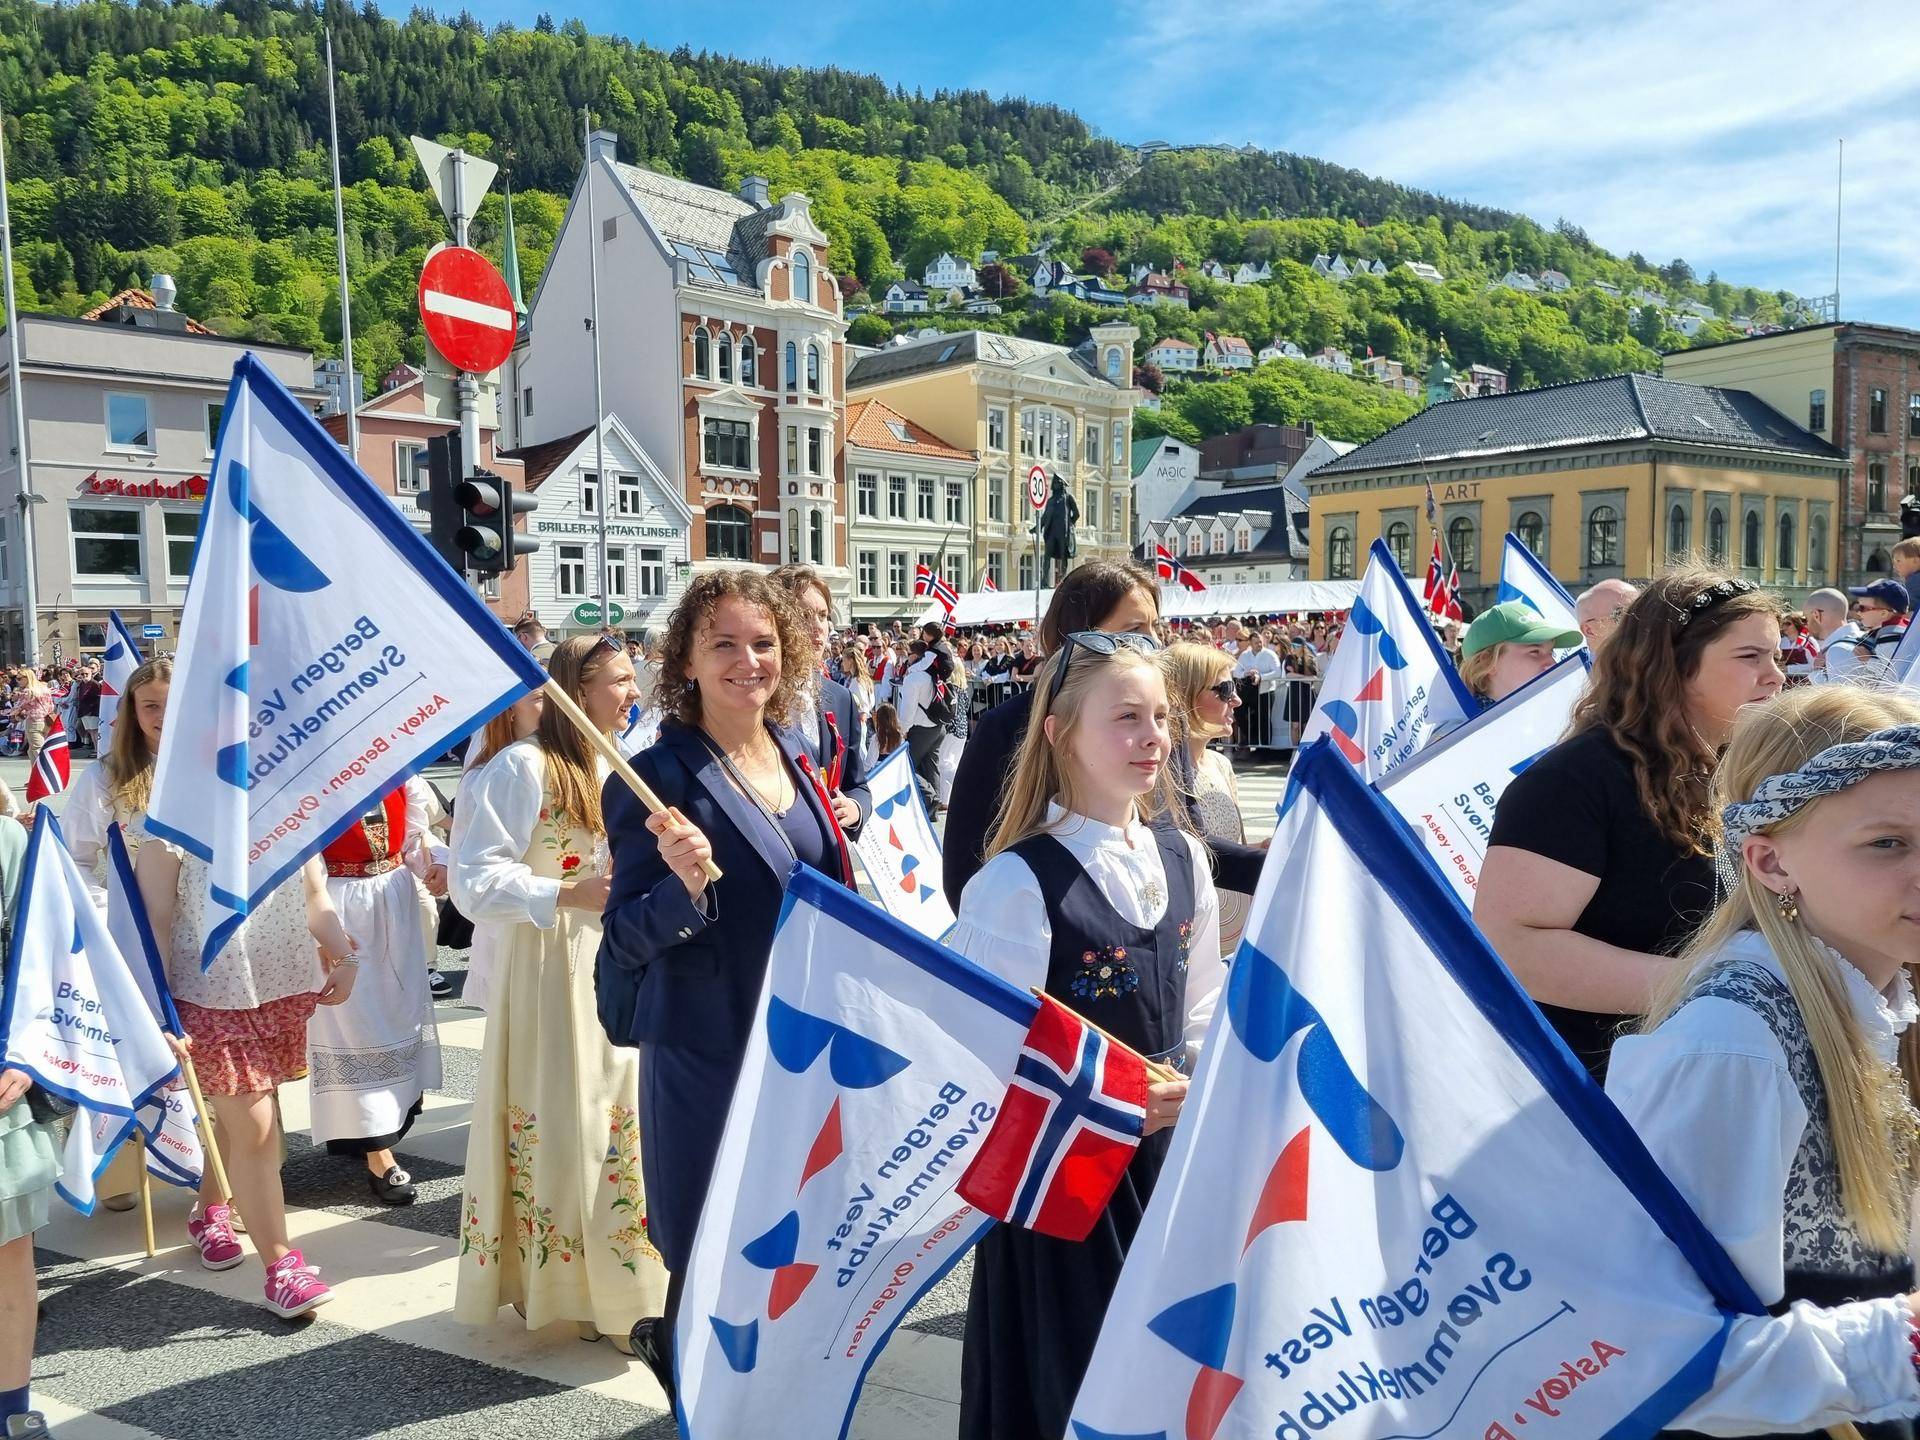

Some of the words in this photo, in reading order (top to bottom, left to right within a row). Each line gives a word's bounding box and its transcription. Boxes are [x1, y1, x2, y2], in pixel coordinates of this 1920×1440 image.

[1032, 476, 1044, 498] 30
[1444, 482, 1481, 500] ART
[538, 521, 679, 538] BRILLER-KNTAKTLINSER
[579, 609, 620, 619] Specsers
[1473, 782, 1497, 819] Ber
[1421, 813, 1451, 848] Askøy
